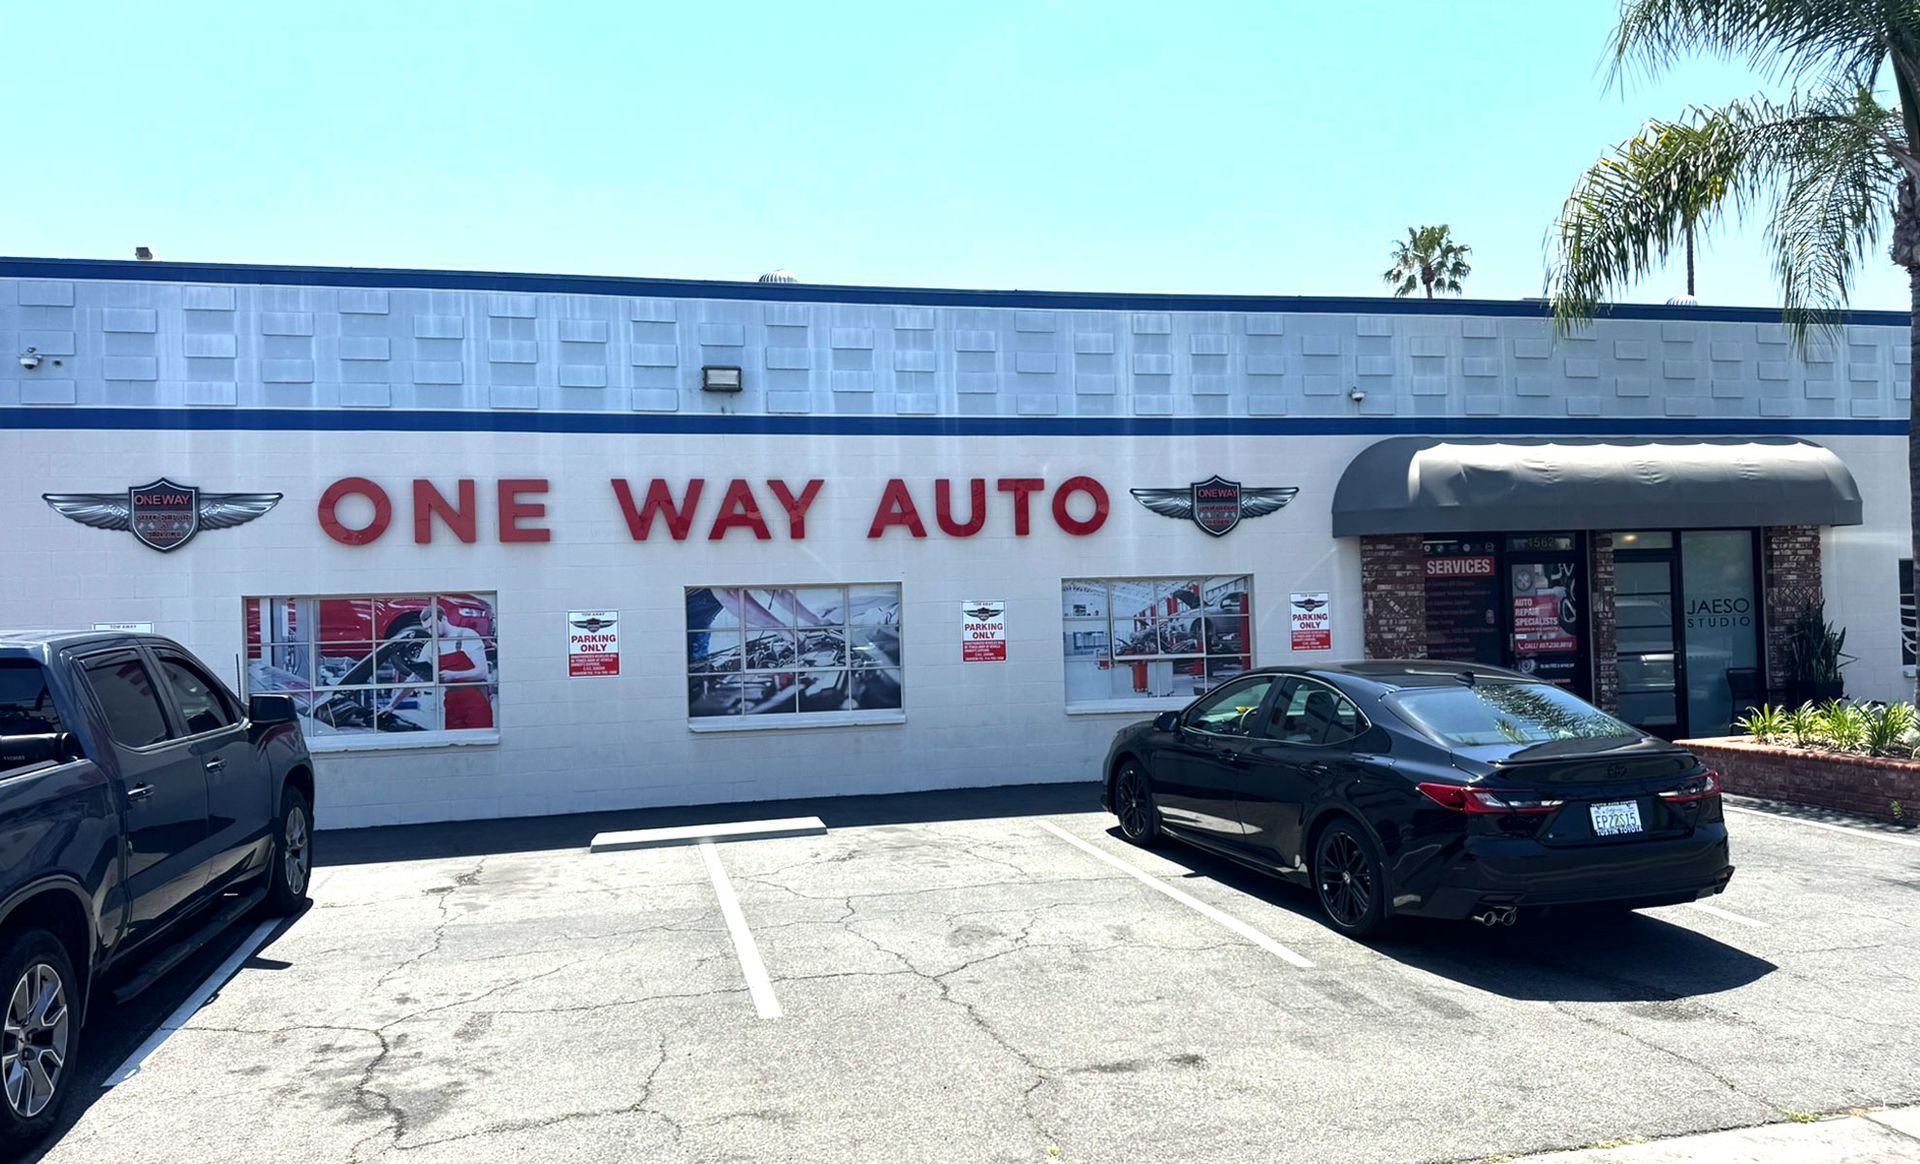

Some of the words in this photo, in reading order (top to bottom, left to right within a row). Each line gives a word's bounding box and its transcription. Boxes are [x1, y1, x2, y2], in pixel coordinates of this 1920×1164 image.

[318, 476, 551, 545] ONE
[611, 477, 825, 541] WAY
[867, 475, 1110, 538] AUTO
[1426, 558, 1491, 576] SERVICES
[1687, 598, 1750, 615] JAESO
[1292, 613, 1328, 621] PARKING
[1515, 616, 1558, 626] SPECIALISTS
[964, 622, 1004, 631] PARKING
[1299, 621, 1321, 629] ONLY
[1687, 616, 1751, 628] STUDIO
[571, 634, 616, 643] PARKING
[972, 631, 996, 640] ONLY
[580, 643, 607, 652] ONLY
